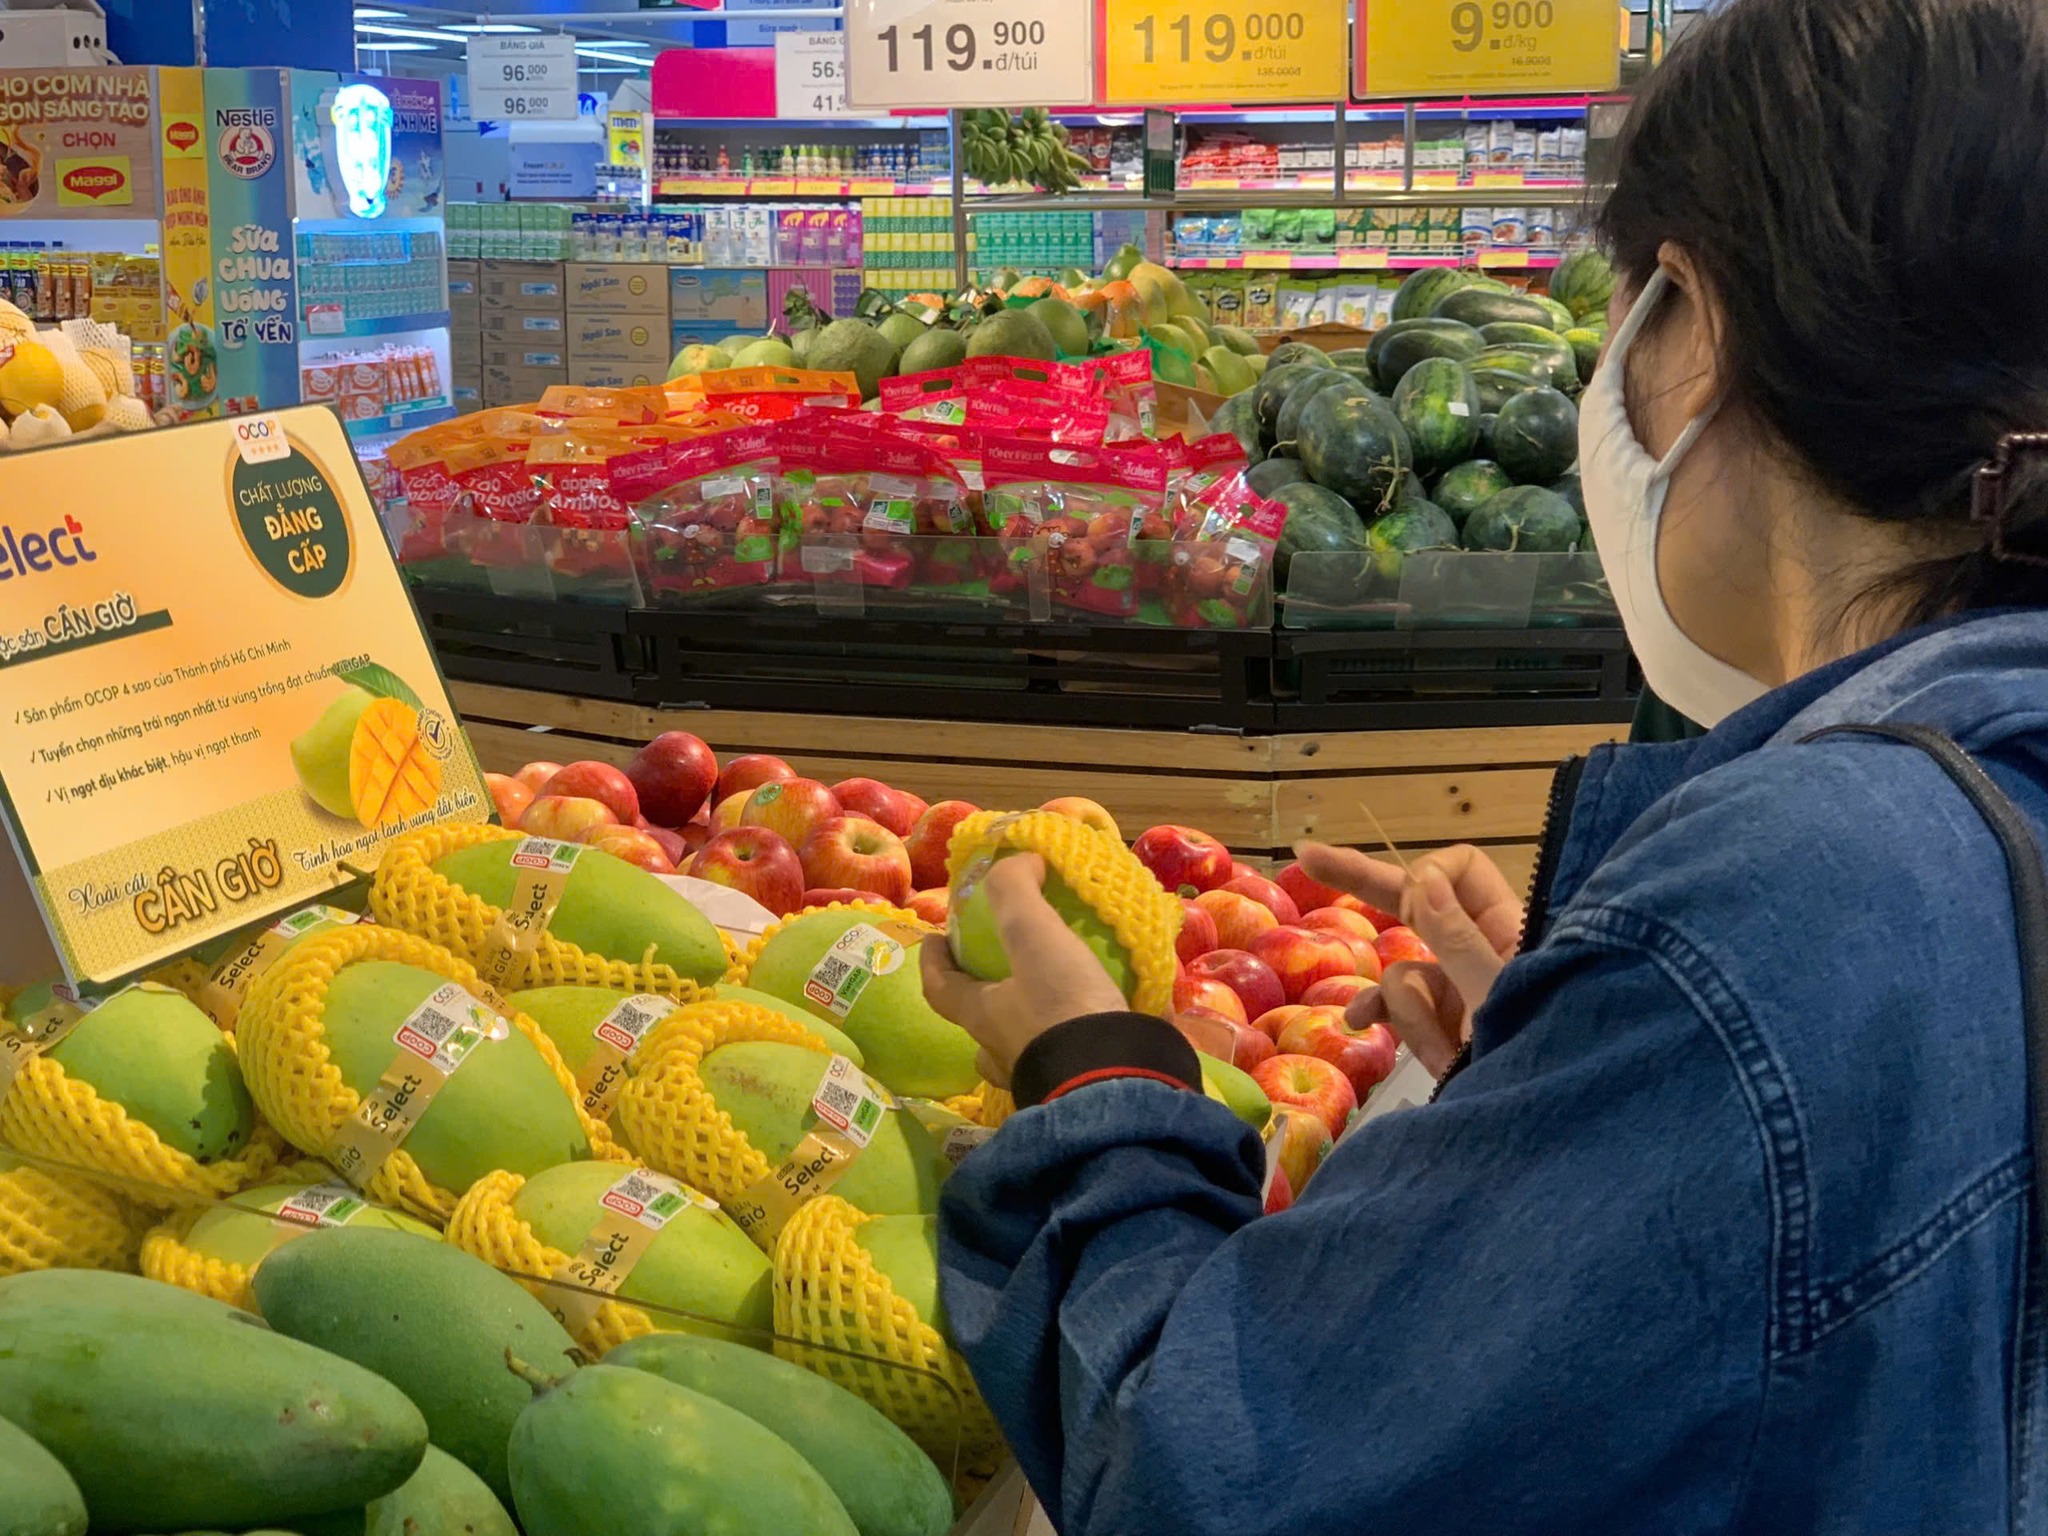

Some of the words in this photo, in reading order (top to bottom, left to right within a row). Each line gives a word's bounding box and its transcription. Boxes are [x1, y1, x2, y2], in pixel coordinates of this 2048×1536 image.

[33, 75, 91, 95] CƠM
[97, 74, 149, 97] NHÀ
[44, 97, 102, 118] SÁNG
[105, 101, 149, 122] TẠO
[62, 132, 116, 149] CHỌN
[69, 173, 117, 187] Maggi
[246, 153, 272, 175] BRAND
[254, 316, 292, 342] YẾN
[238, 420, 276, 441] OCOP
[239, 479, 273, 506] CHẤT
[276, 475, 323, 500] LƯỢNG
[264, 503, 324, 540] ĐẲNG
[288, 538, 327, 574] CẤP
[44, 604, 93, 639] CẦN
[95, 593, 135, 626] GIỜ
[23, 708, 48, 724] Sản
[84, 683, 119, 706] OCOP
[123, 683, 130, 695] 4
[132, 683, 151, 694] sao
[153, 672, 173, 687] của
[174, 662, 209, 681] Thành
[210, 655, 230, 673] phố
[230, 649, 246, 666] Hồ
[247, 644, 265, 660] Chí
[266, 638, 292, 655] Minh
[38, 741, 75, 764] Tuyển
[76, 735, 104, 752] chọn
[106, 726, 143, 743] những
[143, 715, 163, 732] trái
[164, 709, 191, 727] ngon
[192, 698, 217, 718] nhất
[232, 690, 257, 704] vùng
[286, 672, 304, 690] đạt
[54, 787, 71, 804] Vị
[70, 779, 98, 799] ngọt
[99, 773, 118, 790] dịu
[116, 764, 145, 782] khác
[145, 756, 172, 774] biệt,
[171, 750, 193, 766] hậu
[194, 743, 206, 760] vị
[206, 737, 230, 755] ngọt
[230, 726, 262, 746] thanh
[331, 839, 353, 859] hoa
[355, 829, 380, 853] ngọt
[381, 814, 408, 839] lành
[409, 810, 435, 829] vùng
[436, 797, 453, 818] đất
[124, 874, 149, 902] cát
[133, 866, 216, 933] CẦN
[216, 838, 283, 901] GIỜ
[837, 926, 863, 950] OCO
[219, 940, 266, 989] Select
[371, 1074, 422, 1133] Select
[583, 1065, 620, 1112] elect
[784, 1146, 836, 1196] Select
[578, 1232, 629, 1286] Select
